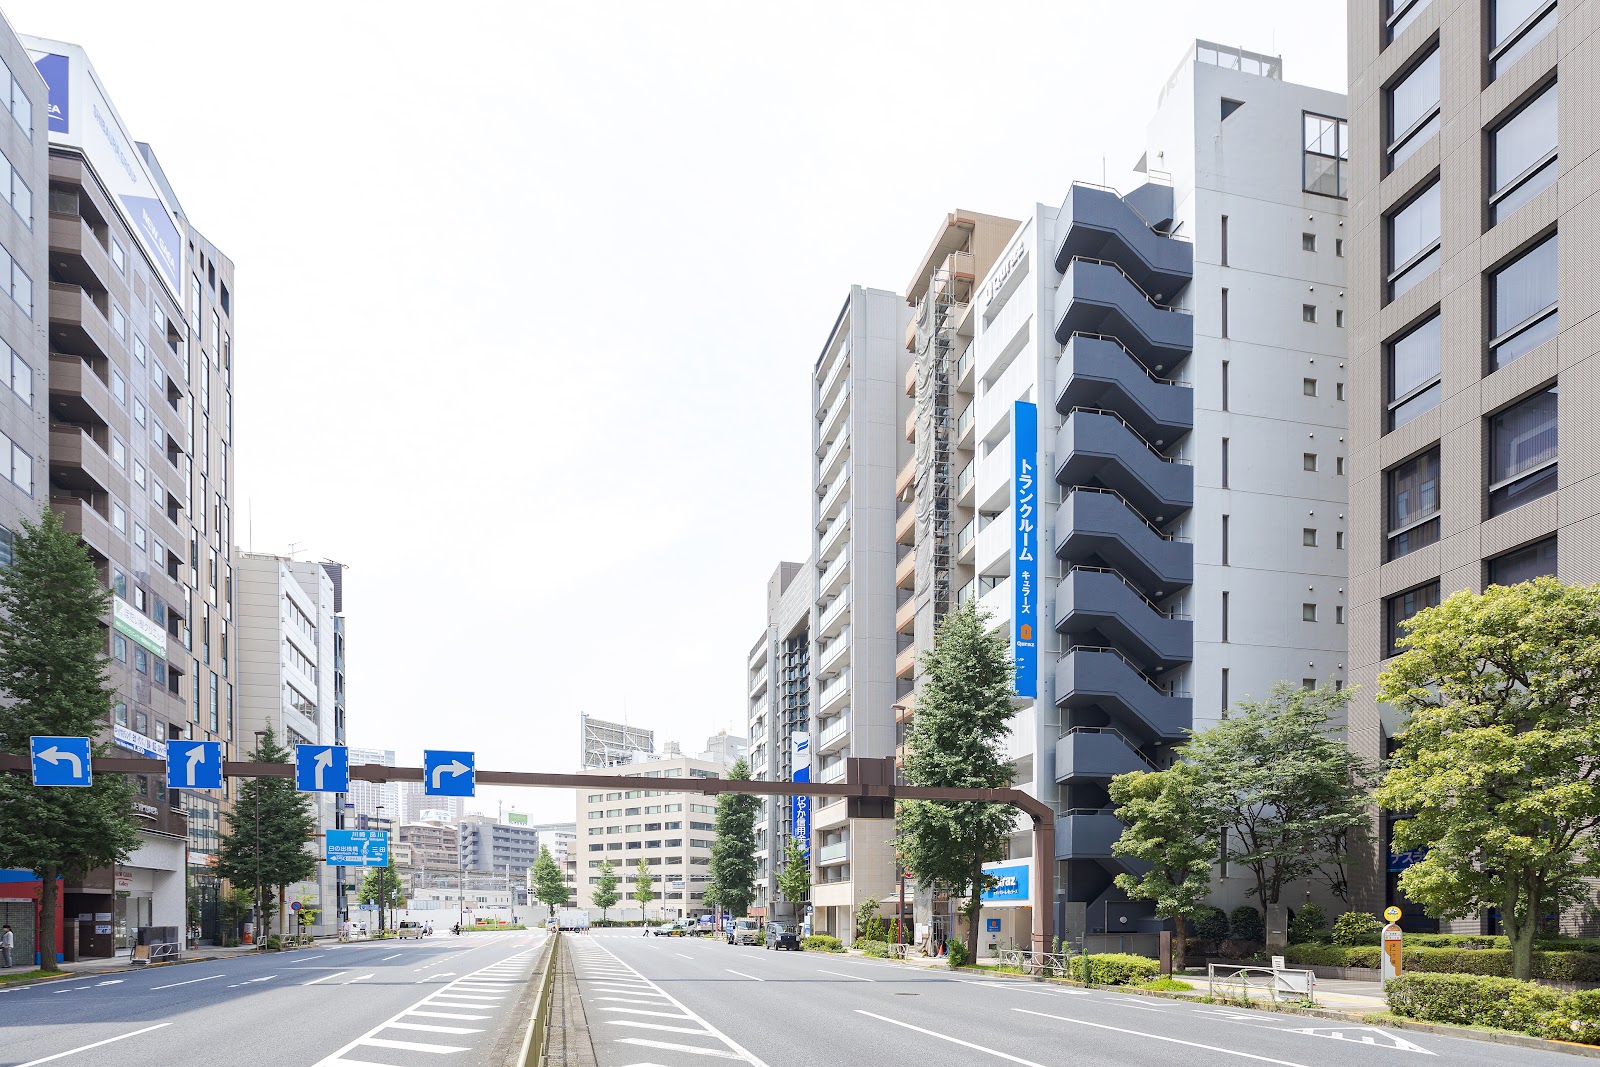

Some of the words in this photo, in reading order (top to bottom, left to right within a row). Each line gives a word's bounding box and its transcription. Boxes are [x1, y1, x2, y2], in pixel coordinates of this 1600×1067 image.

[142, 208, 158, 239] NEW
[159, 238, 175, 271] GAEA
[1018, 458, 1034, 562] トランクルーム
[1021, 570, 1031, 614] キュラーズ
